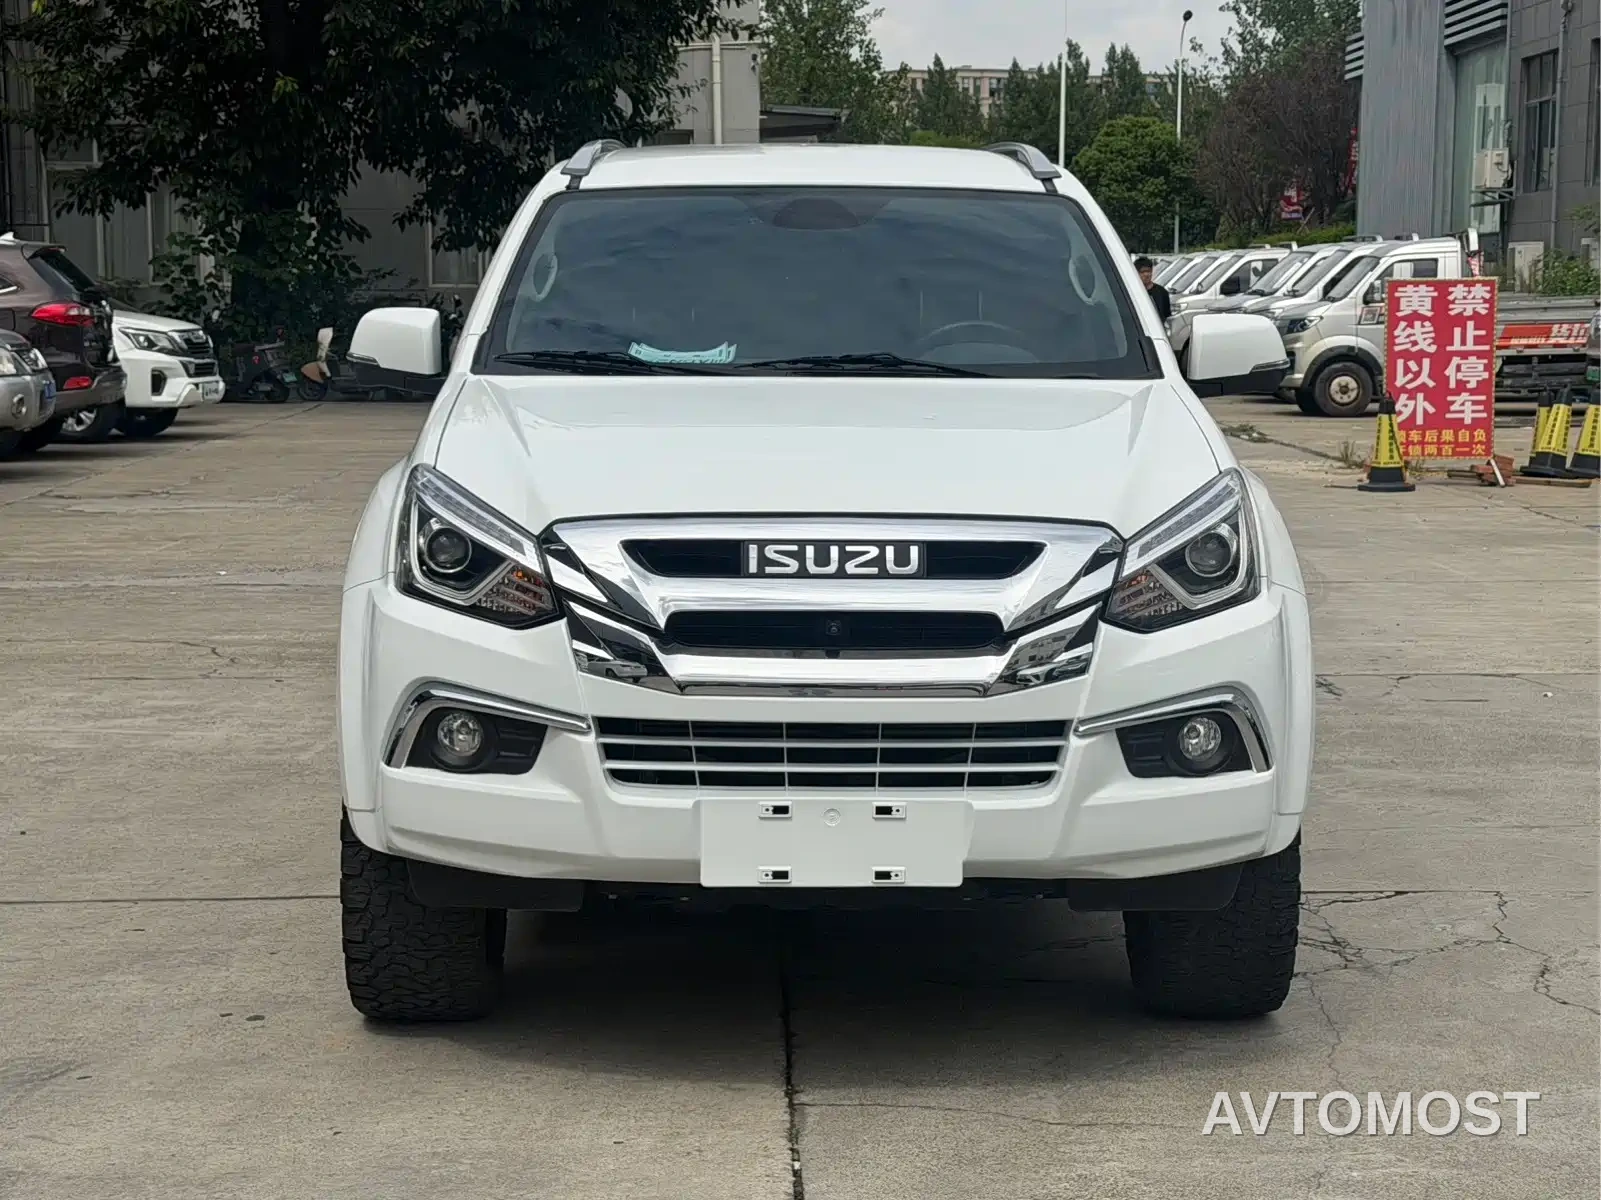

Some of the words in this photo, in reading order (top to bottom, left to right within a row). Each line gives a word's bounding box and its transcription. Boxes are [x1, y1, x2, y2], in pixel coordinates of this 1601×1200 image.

[1393, 284, 1438, 425] 黄线以外
[1444, 283, 1492, 425] 禁止停车
[748, 544, 919, 574] ISUZU
